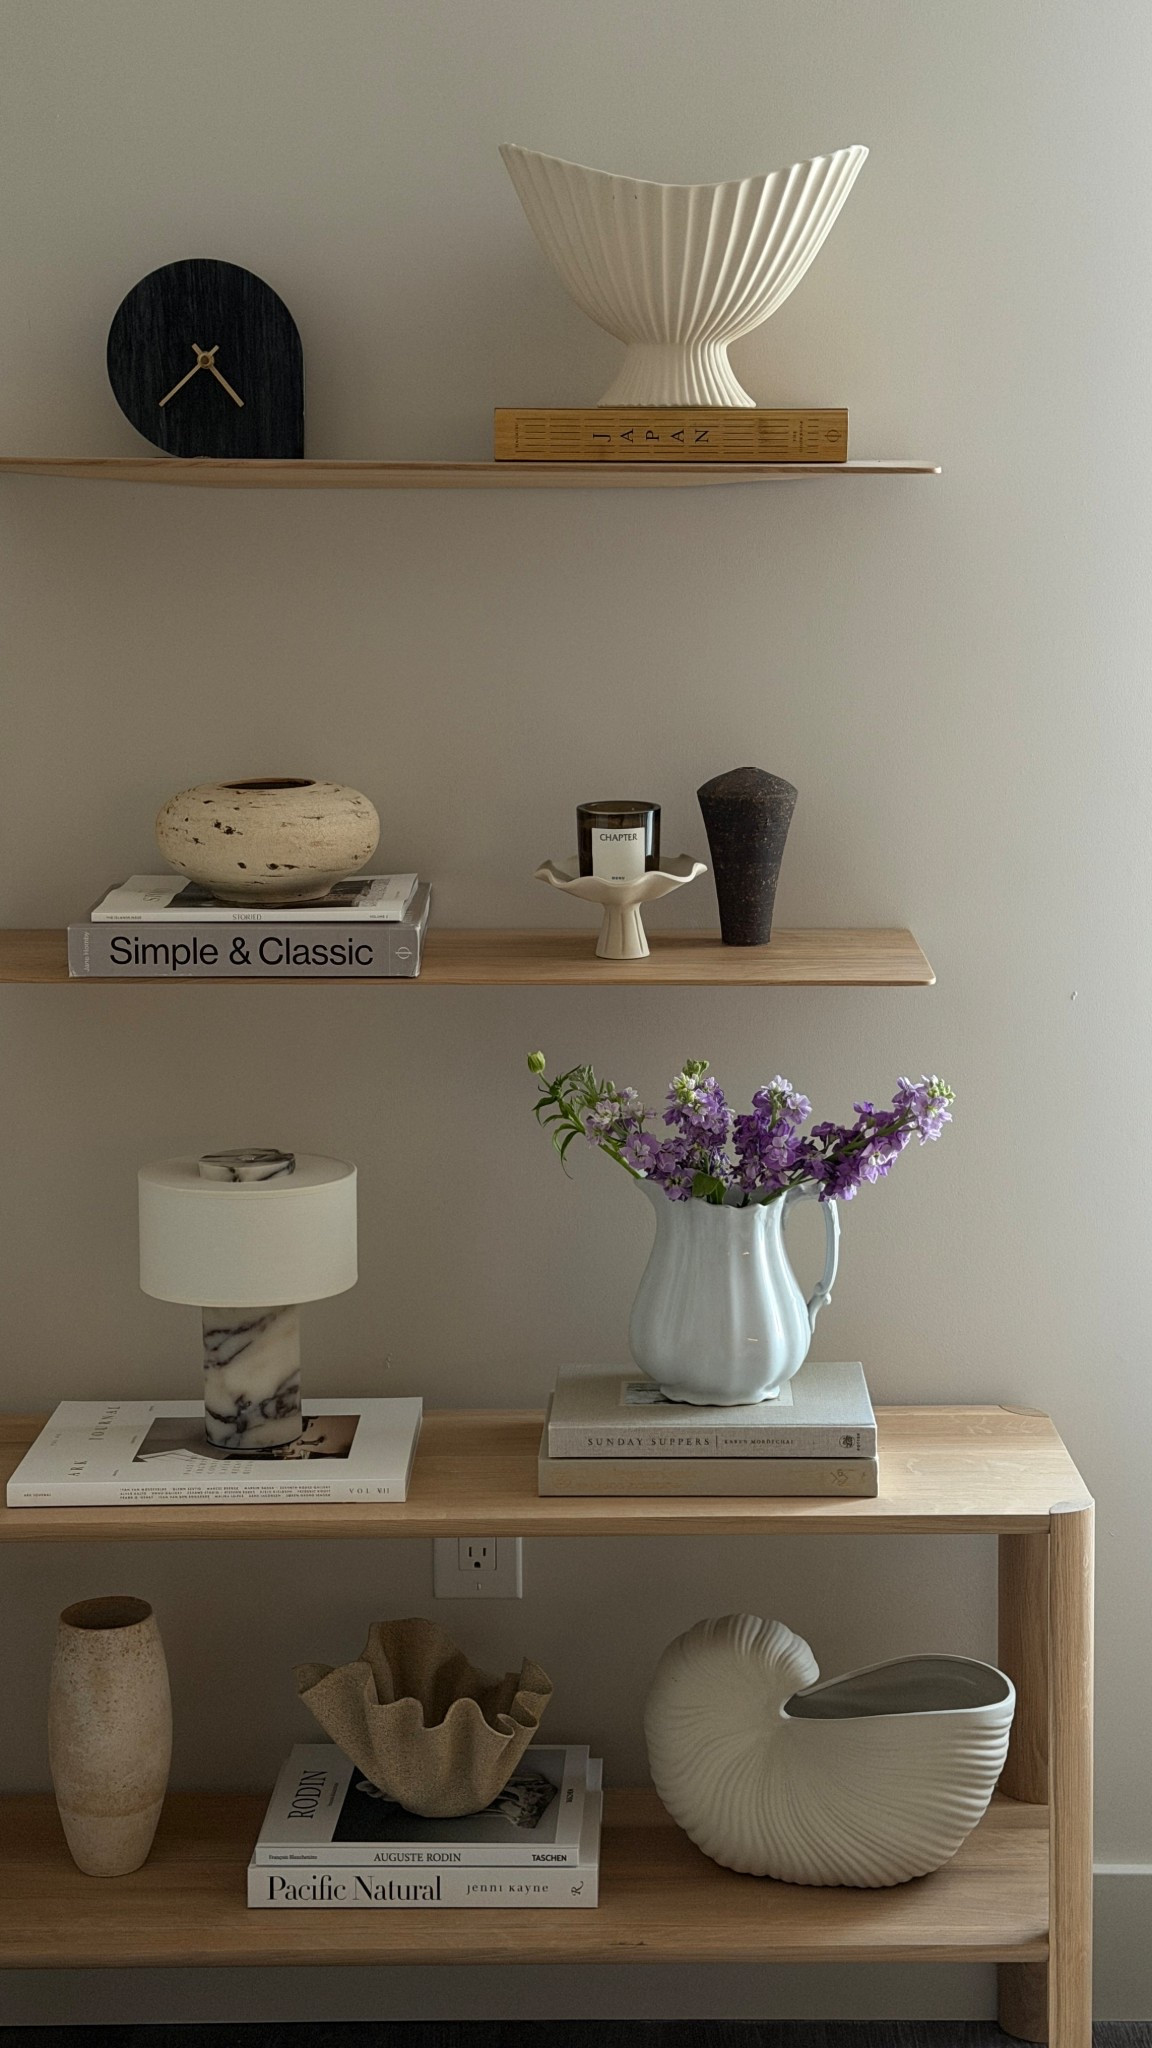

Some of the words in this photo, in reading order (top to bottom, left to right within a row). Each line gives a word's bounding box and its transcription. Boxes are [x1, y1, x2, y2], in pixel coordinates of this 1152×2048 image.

[593, 428, 709, 443] JAPAN
[599, 832, 638, 841] CHAPTER
[109, 936, 219, 971] Simple
[229, 936, 252, 965] &
[259, 936, 374, 965] Classic
[587, 1438, 643, 1446] SUNDAY
[651, 1438, 710, 1446] SUPPERS
[67, 1460, 88, 1477] ARK
[287, 1770, 328, 1819] RODIN
[373, 1852, 423, 1862] AUGUSTE
[426, 1852, 462, 1862] RODIN
[531, 1854, 567, 1862] TASCHEN
[266, 1874, 347, 1901] Pacific
[352, 1874, 442, 1901] Natural
